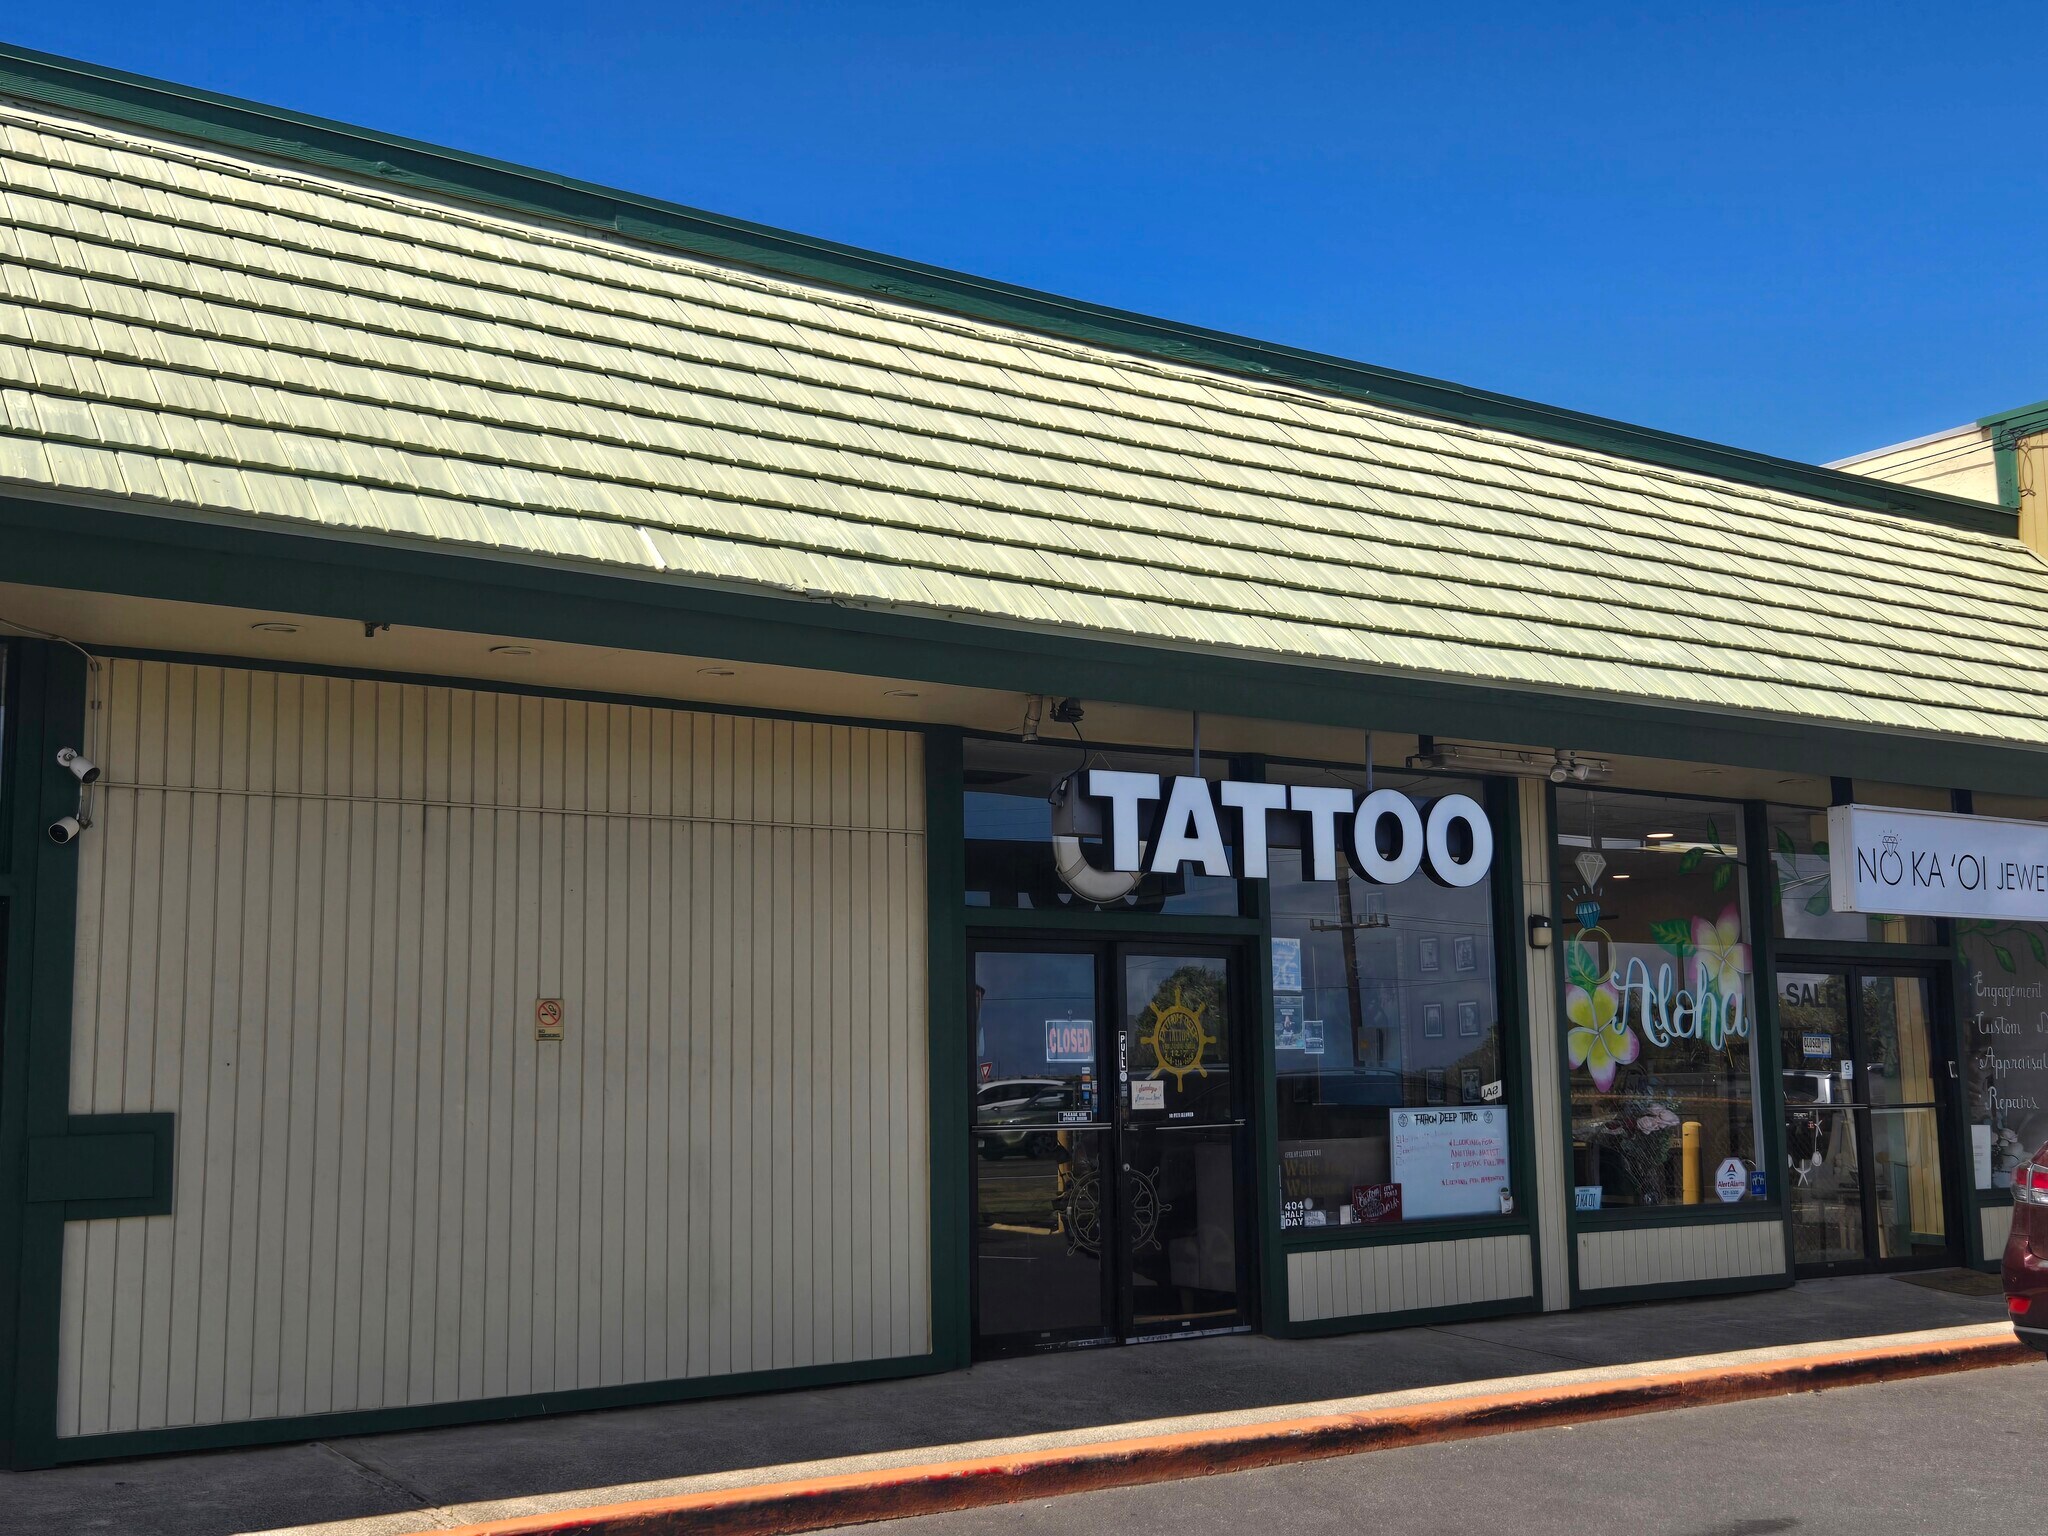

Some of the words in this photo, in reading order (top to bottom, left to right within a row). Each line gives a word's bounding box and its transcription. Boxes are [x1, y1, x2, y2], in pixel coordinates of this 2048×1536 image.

[1088, 769, 1494, 888] TATTOO
[1912, 850, 1946, 888] KA
[1996, 862, 2048, 892] JEWE
[1785, 982, 1838, 1008] SALE
[1973, 971, 2042, 1006] Engagement
[1611, 956, 1749, 1051] Aloha
[1976, 1011, 2022, 1035] Custom
[1049, 1027, 1091, 1053] CLOSED
[1803, 1037, 1821, 1048] CLOSED
[1985, 1086, 2040, 1116] Repairs
[1438, 1112, 1457, 1125] DEEP
[1459, 1111, 1478, 1124] TATTOO
[1284, 1201, 1304, 1211] 404
[1285, 1218, 1304, 1227] DAY
